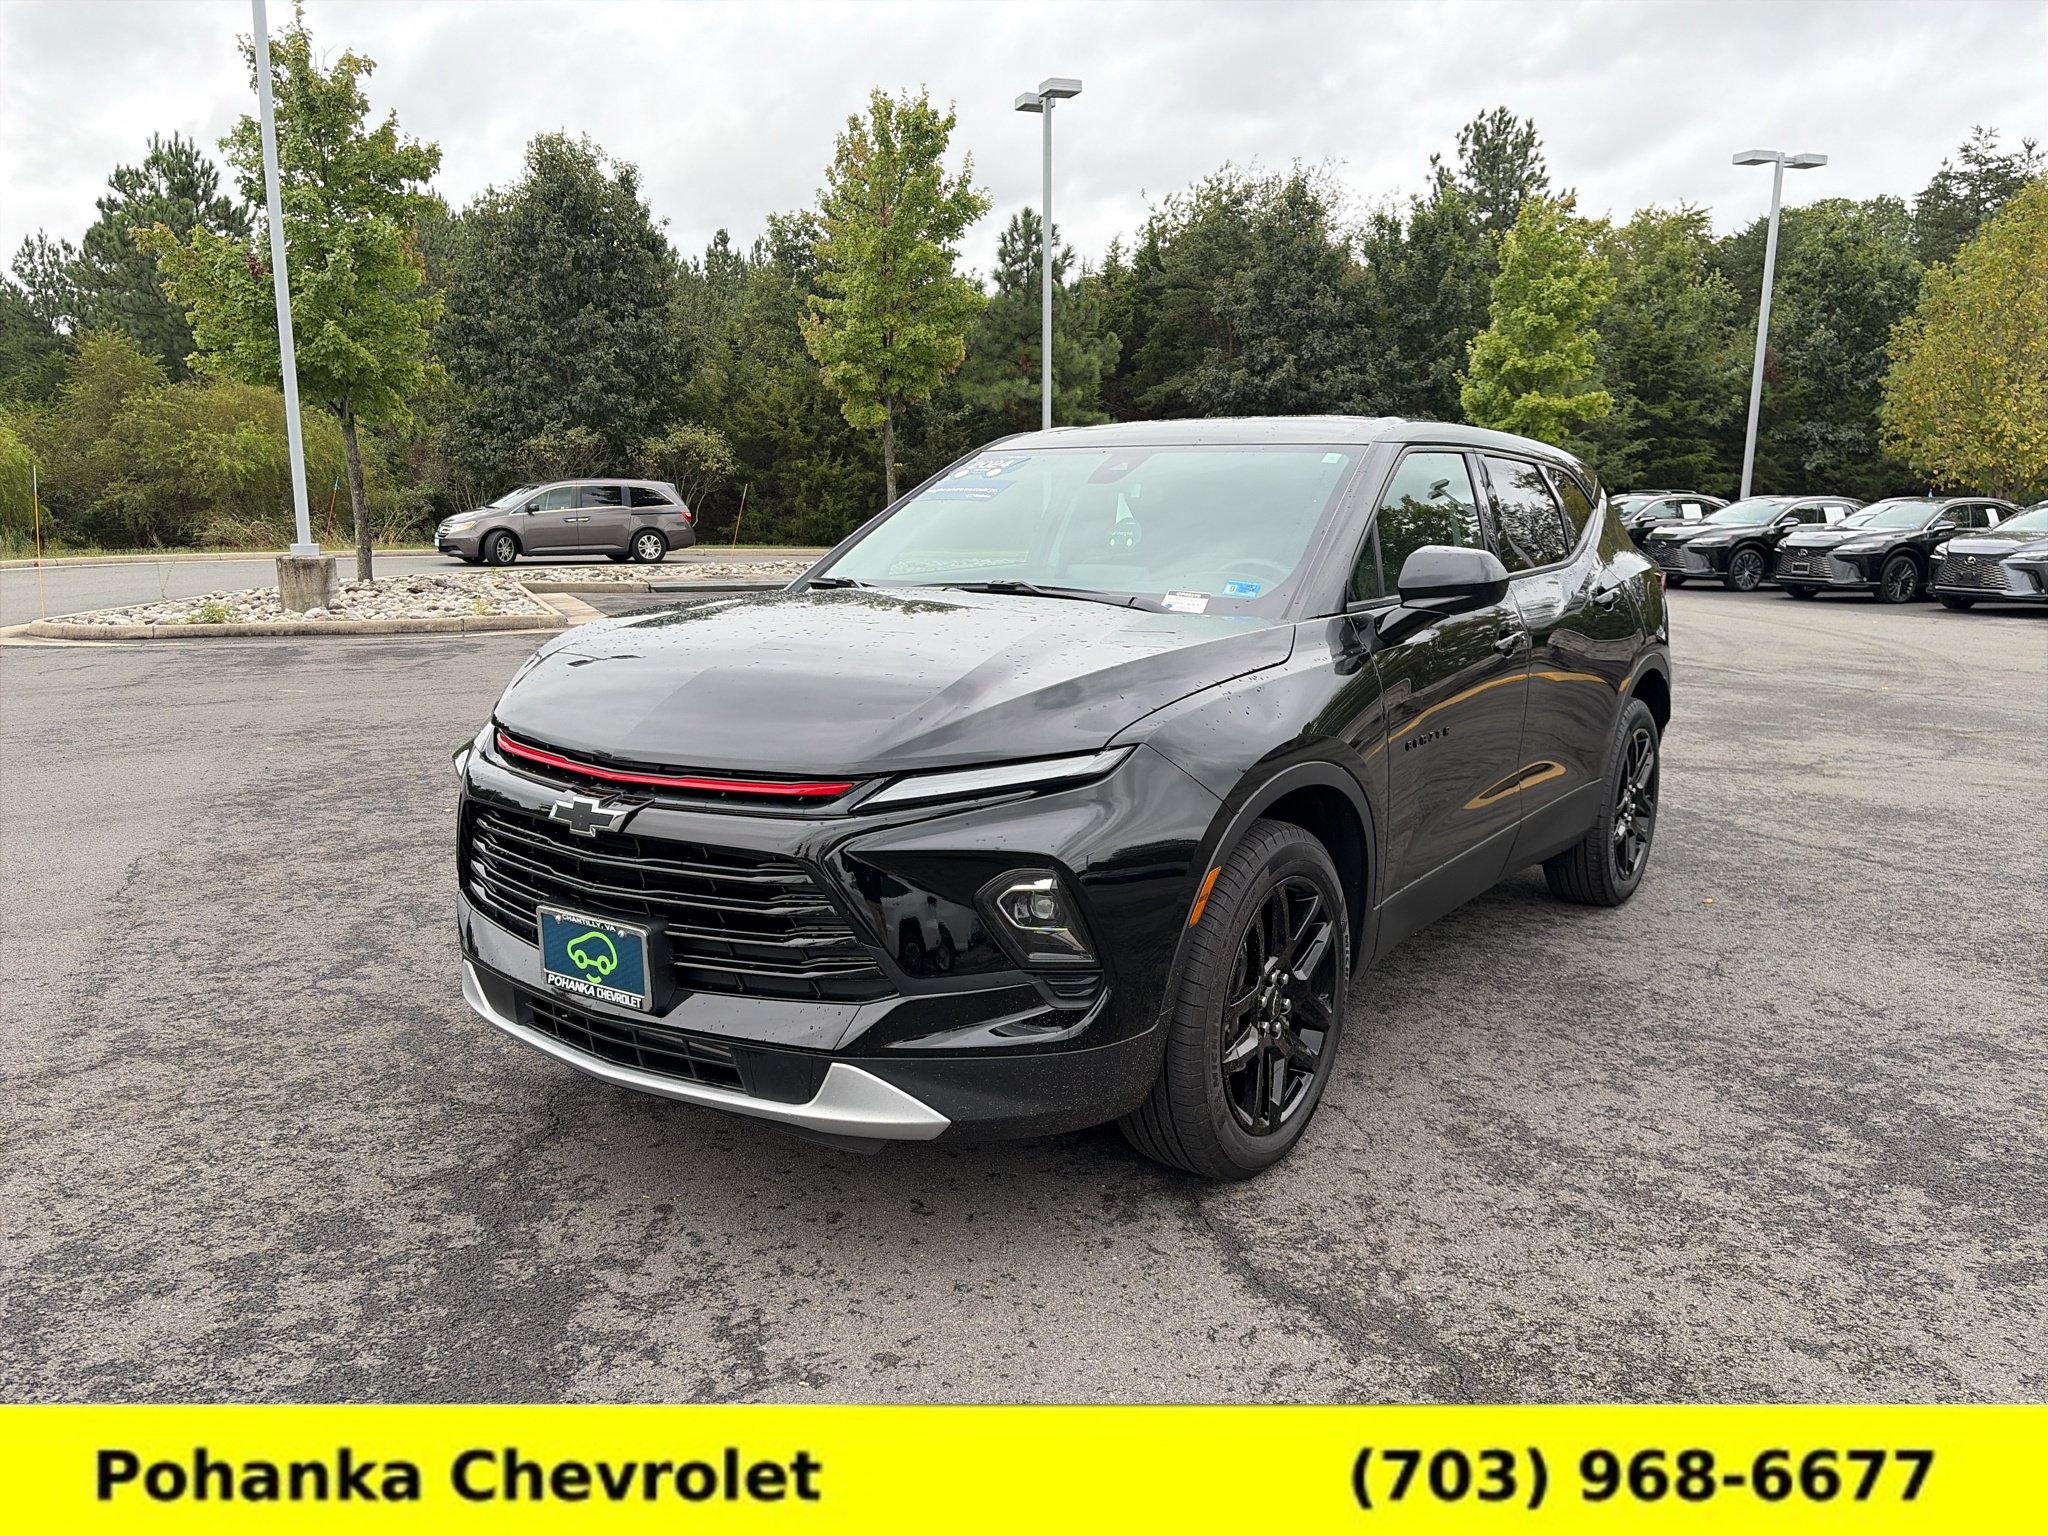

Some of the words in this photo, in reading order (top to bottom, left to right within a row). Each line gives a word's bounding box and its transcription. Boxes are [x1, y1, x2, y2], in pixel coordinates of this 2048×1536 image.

[604, 924, 616, 932] VA
[547, 973, 595, 997] POHANKA
[596, 988, 642, 1008] CHEVROLET
